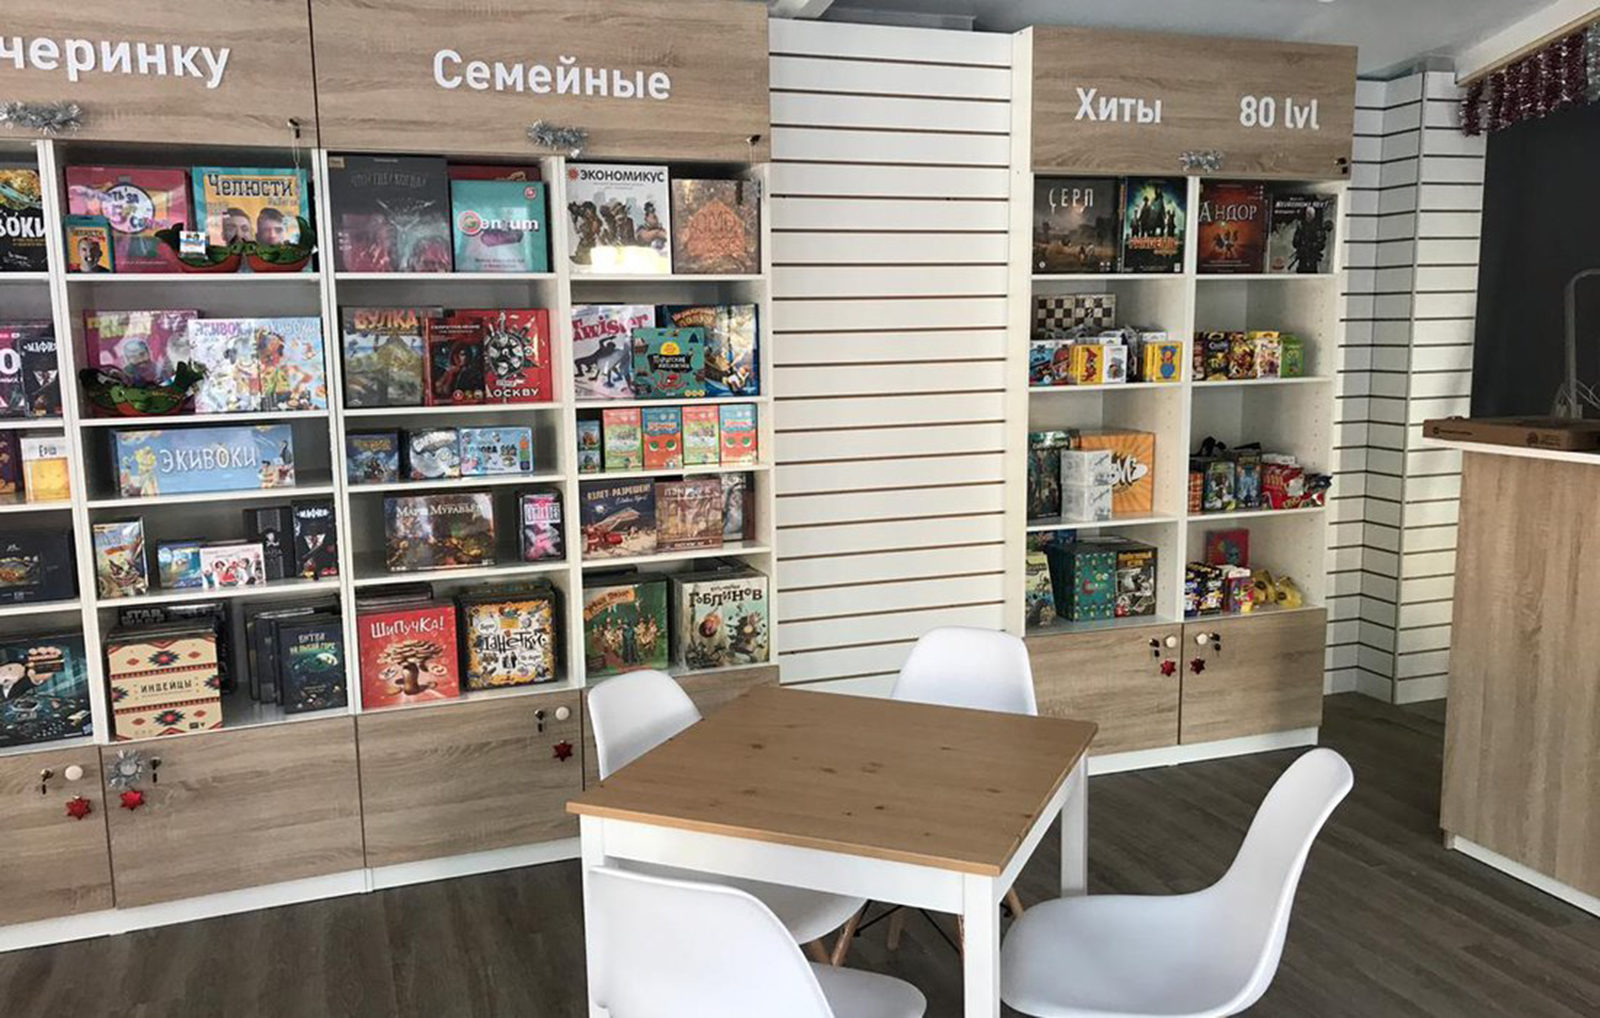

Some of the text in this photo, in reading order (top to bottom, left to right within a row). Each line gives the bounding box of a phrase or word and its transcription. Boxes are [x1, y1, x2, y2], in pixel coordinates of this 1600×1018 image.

[433, 49, 671, 100] Семейные
[1074, 87, 1162, 124] Хиты
[1239, 95, 1320, 130] 80 lvl
[207, 174, 293, 196] Челюсти
[579, 168, 665, 183] ЭКОНОМИКУС
[159, 444, 257, 473] ЭКИВОКИ
[140, 679, 192, 693] ИНДЕЙЦЫ
